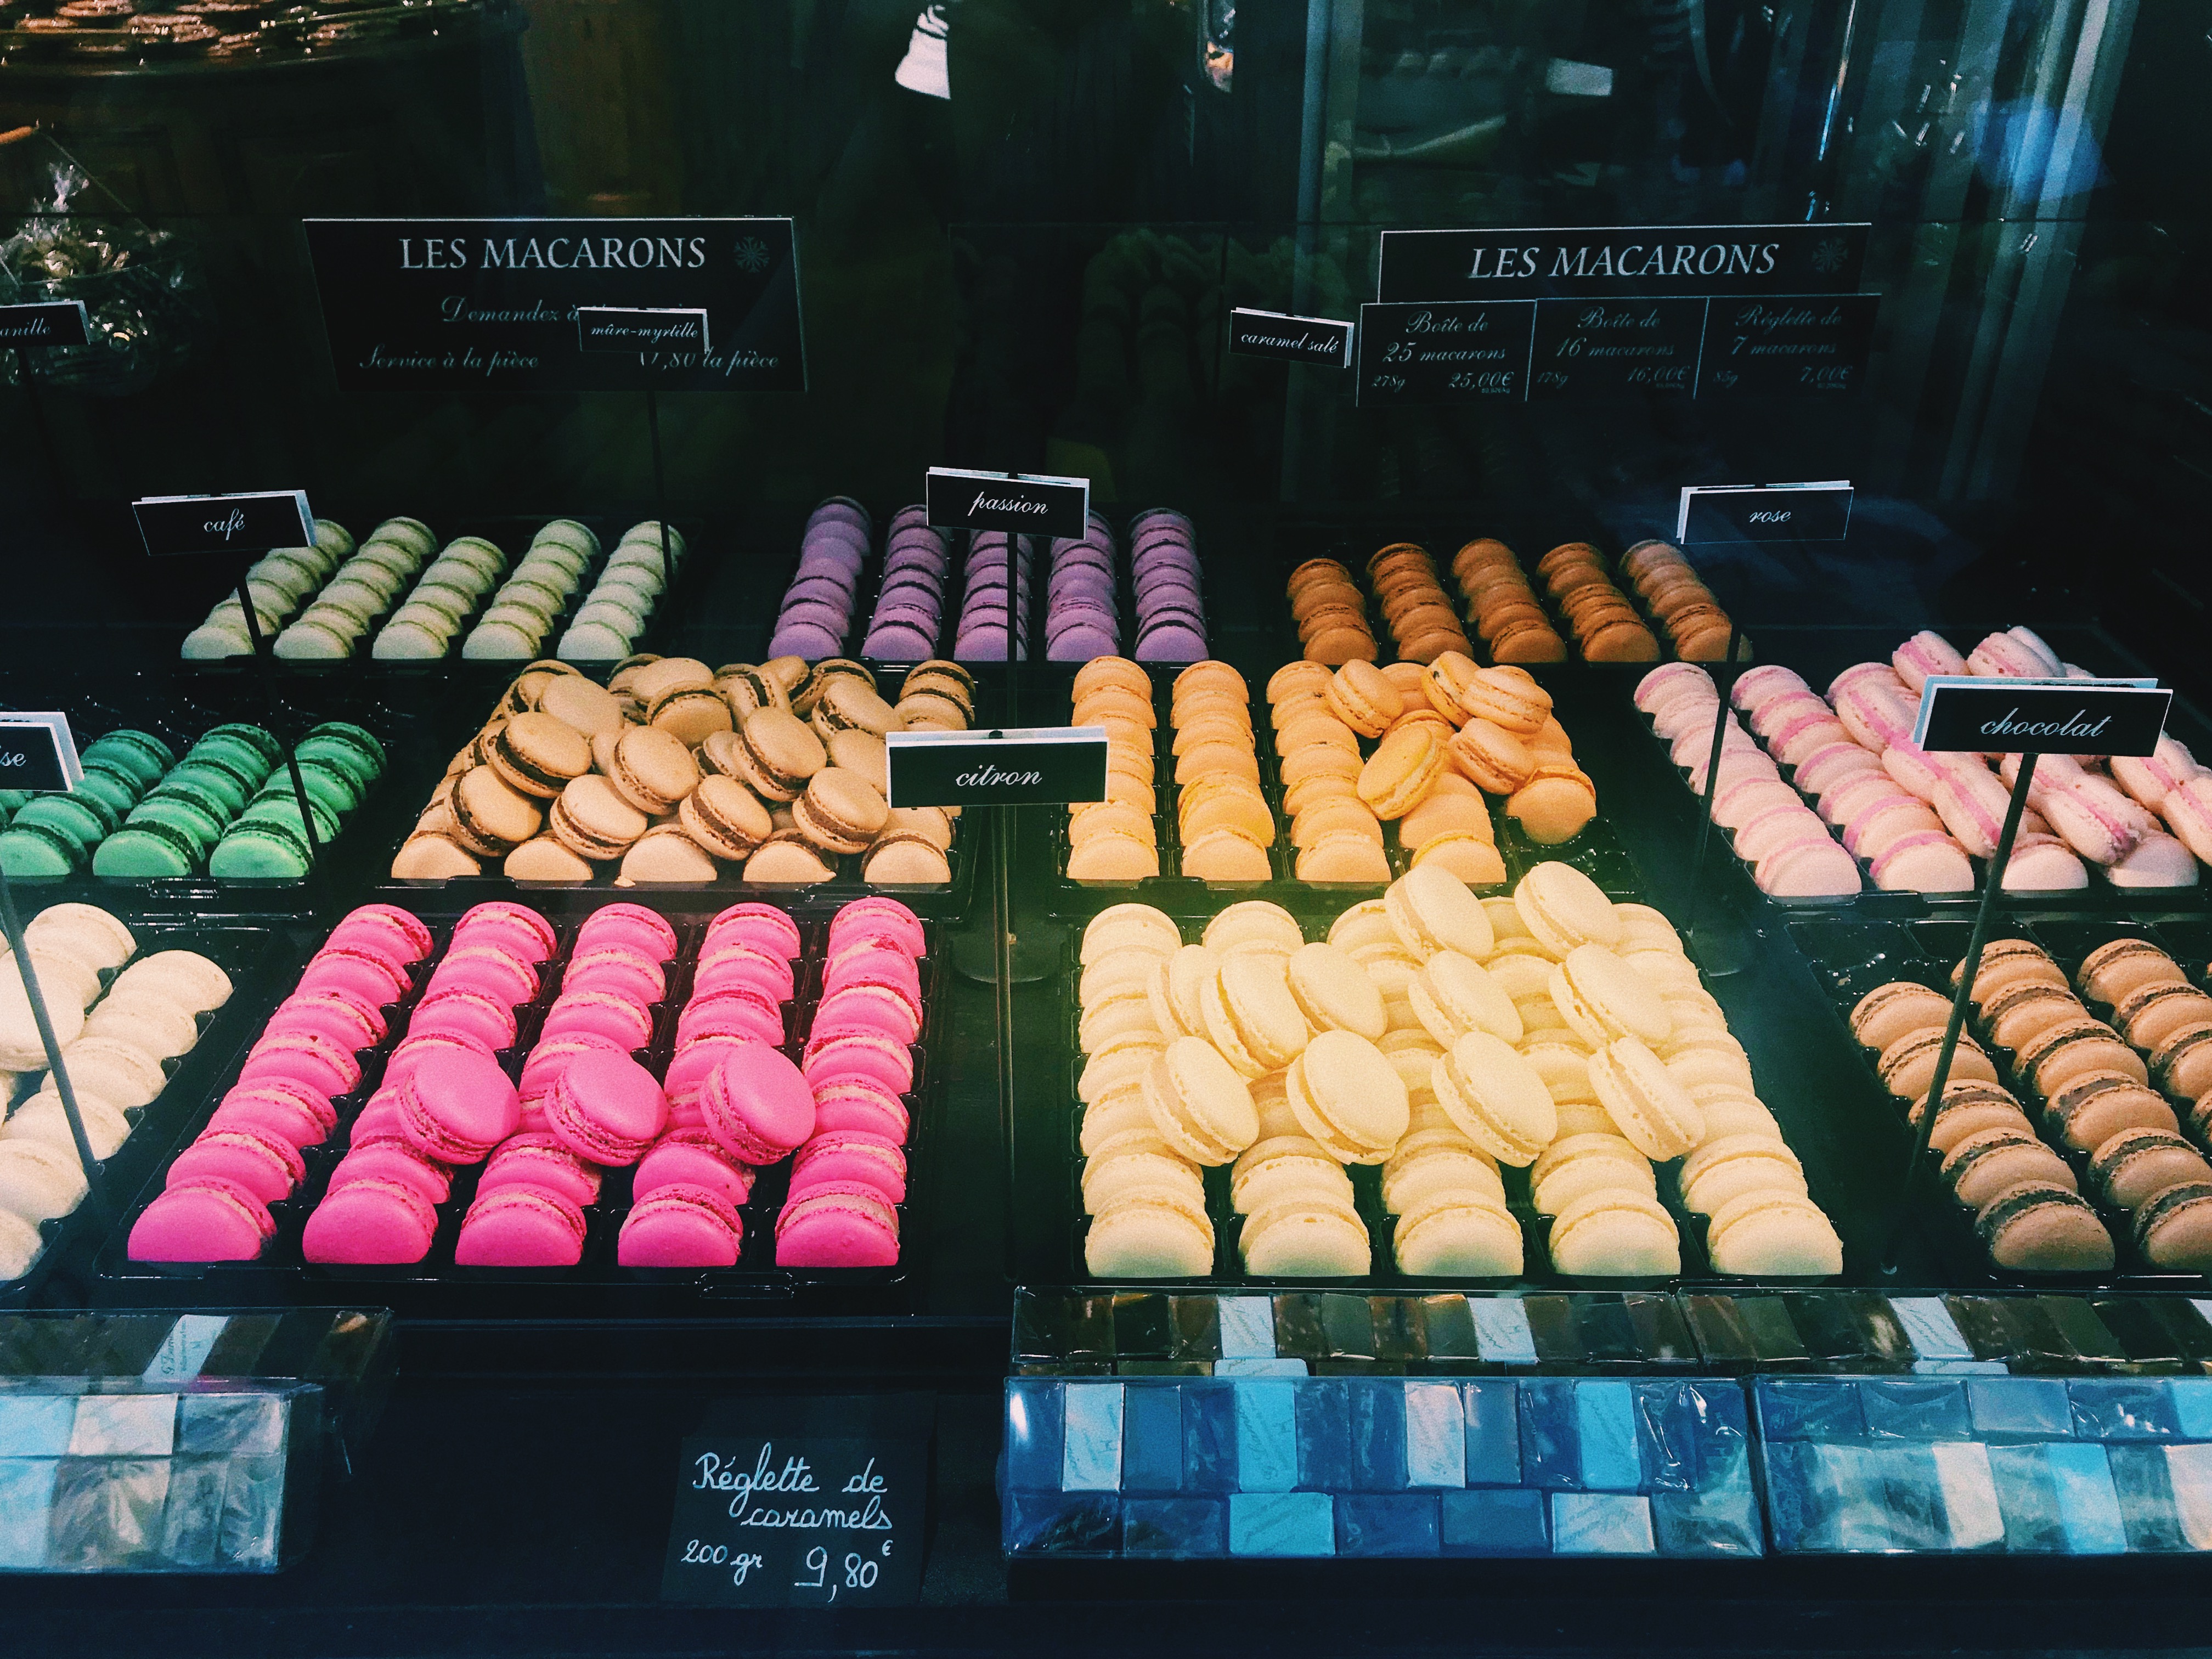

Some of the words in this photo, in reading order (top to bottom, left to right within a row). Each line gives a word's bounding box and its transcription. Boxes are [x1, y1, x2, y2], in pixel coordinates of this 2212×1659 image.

[399, 238, 466, 269] LES
[481, 238, 705, 269] MACARONS
[1468, 247, 1539, 278] LES
[1548, 243, 1779, 276] MACARONS
[441, 296, 561, 322] Demandez
[1577, 306, 1635, 328] Boîte
[1639, 308, 1661, 328] de
[1735, 304, 1816, 335] Réglette
[1820, 306, 1842, 325] de
[0, 318, 51, 337] anille
[591, 323, 698, 343] mûre-myrtille
[1406, 311, 1463, 334] Boîte
[1468, 312, 1488, 332] de
[1241, 332, 1309, 349] caramel
[1307, 336, 1339, 353] salé
[1383, 342, 1417, 362] 25
[1419, 349, 1506, 362] macarons
[1556, 337, 1587, 357] 16
[1588, 345, 1675, 357] macarons
[1731, 335, 1749, 356] 7
[1750, 343, 1837, 355] macarons
[359, 343, 437, 368] Service
[442, 352, 455, 368] à
[462, 347, 483, 368] la
[486, 351, 539, 376] pièce
[703, 346, 723, 368] la
[725, 351, 779, 376] pièce
[1372, 375, 1406, 393] 278g
[1448, 371, 1515, 390] 25,00€
[1537, 371, 1569, 389] 178g
[1627, 365, 1690, 385] 16,00€
[1800, 365, 1854, 383] 7,00€
[968, 491, 1049, 517] passion
[204, 508, 245, 541] café
[1750, 510, 1791, 522] rose
[1980, 708, 2113, 737] chocolat
[0, 752, 26, 766] se
[955, 765, 1042, 786] citron
[693, 1442, 820, 1517] Réglette
[842, 1457, 888, 1492] de
[741, 1495, 893, 1530] caramels
[681, 1539, 727, 1564] 200
[730, 1553, 763, 1586] gr
